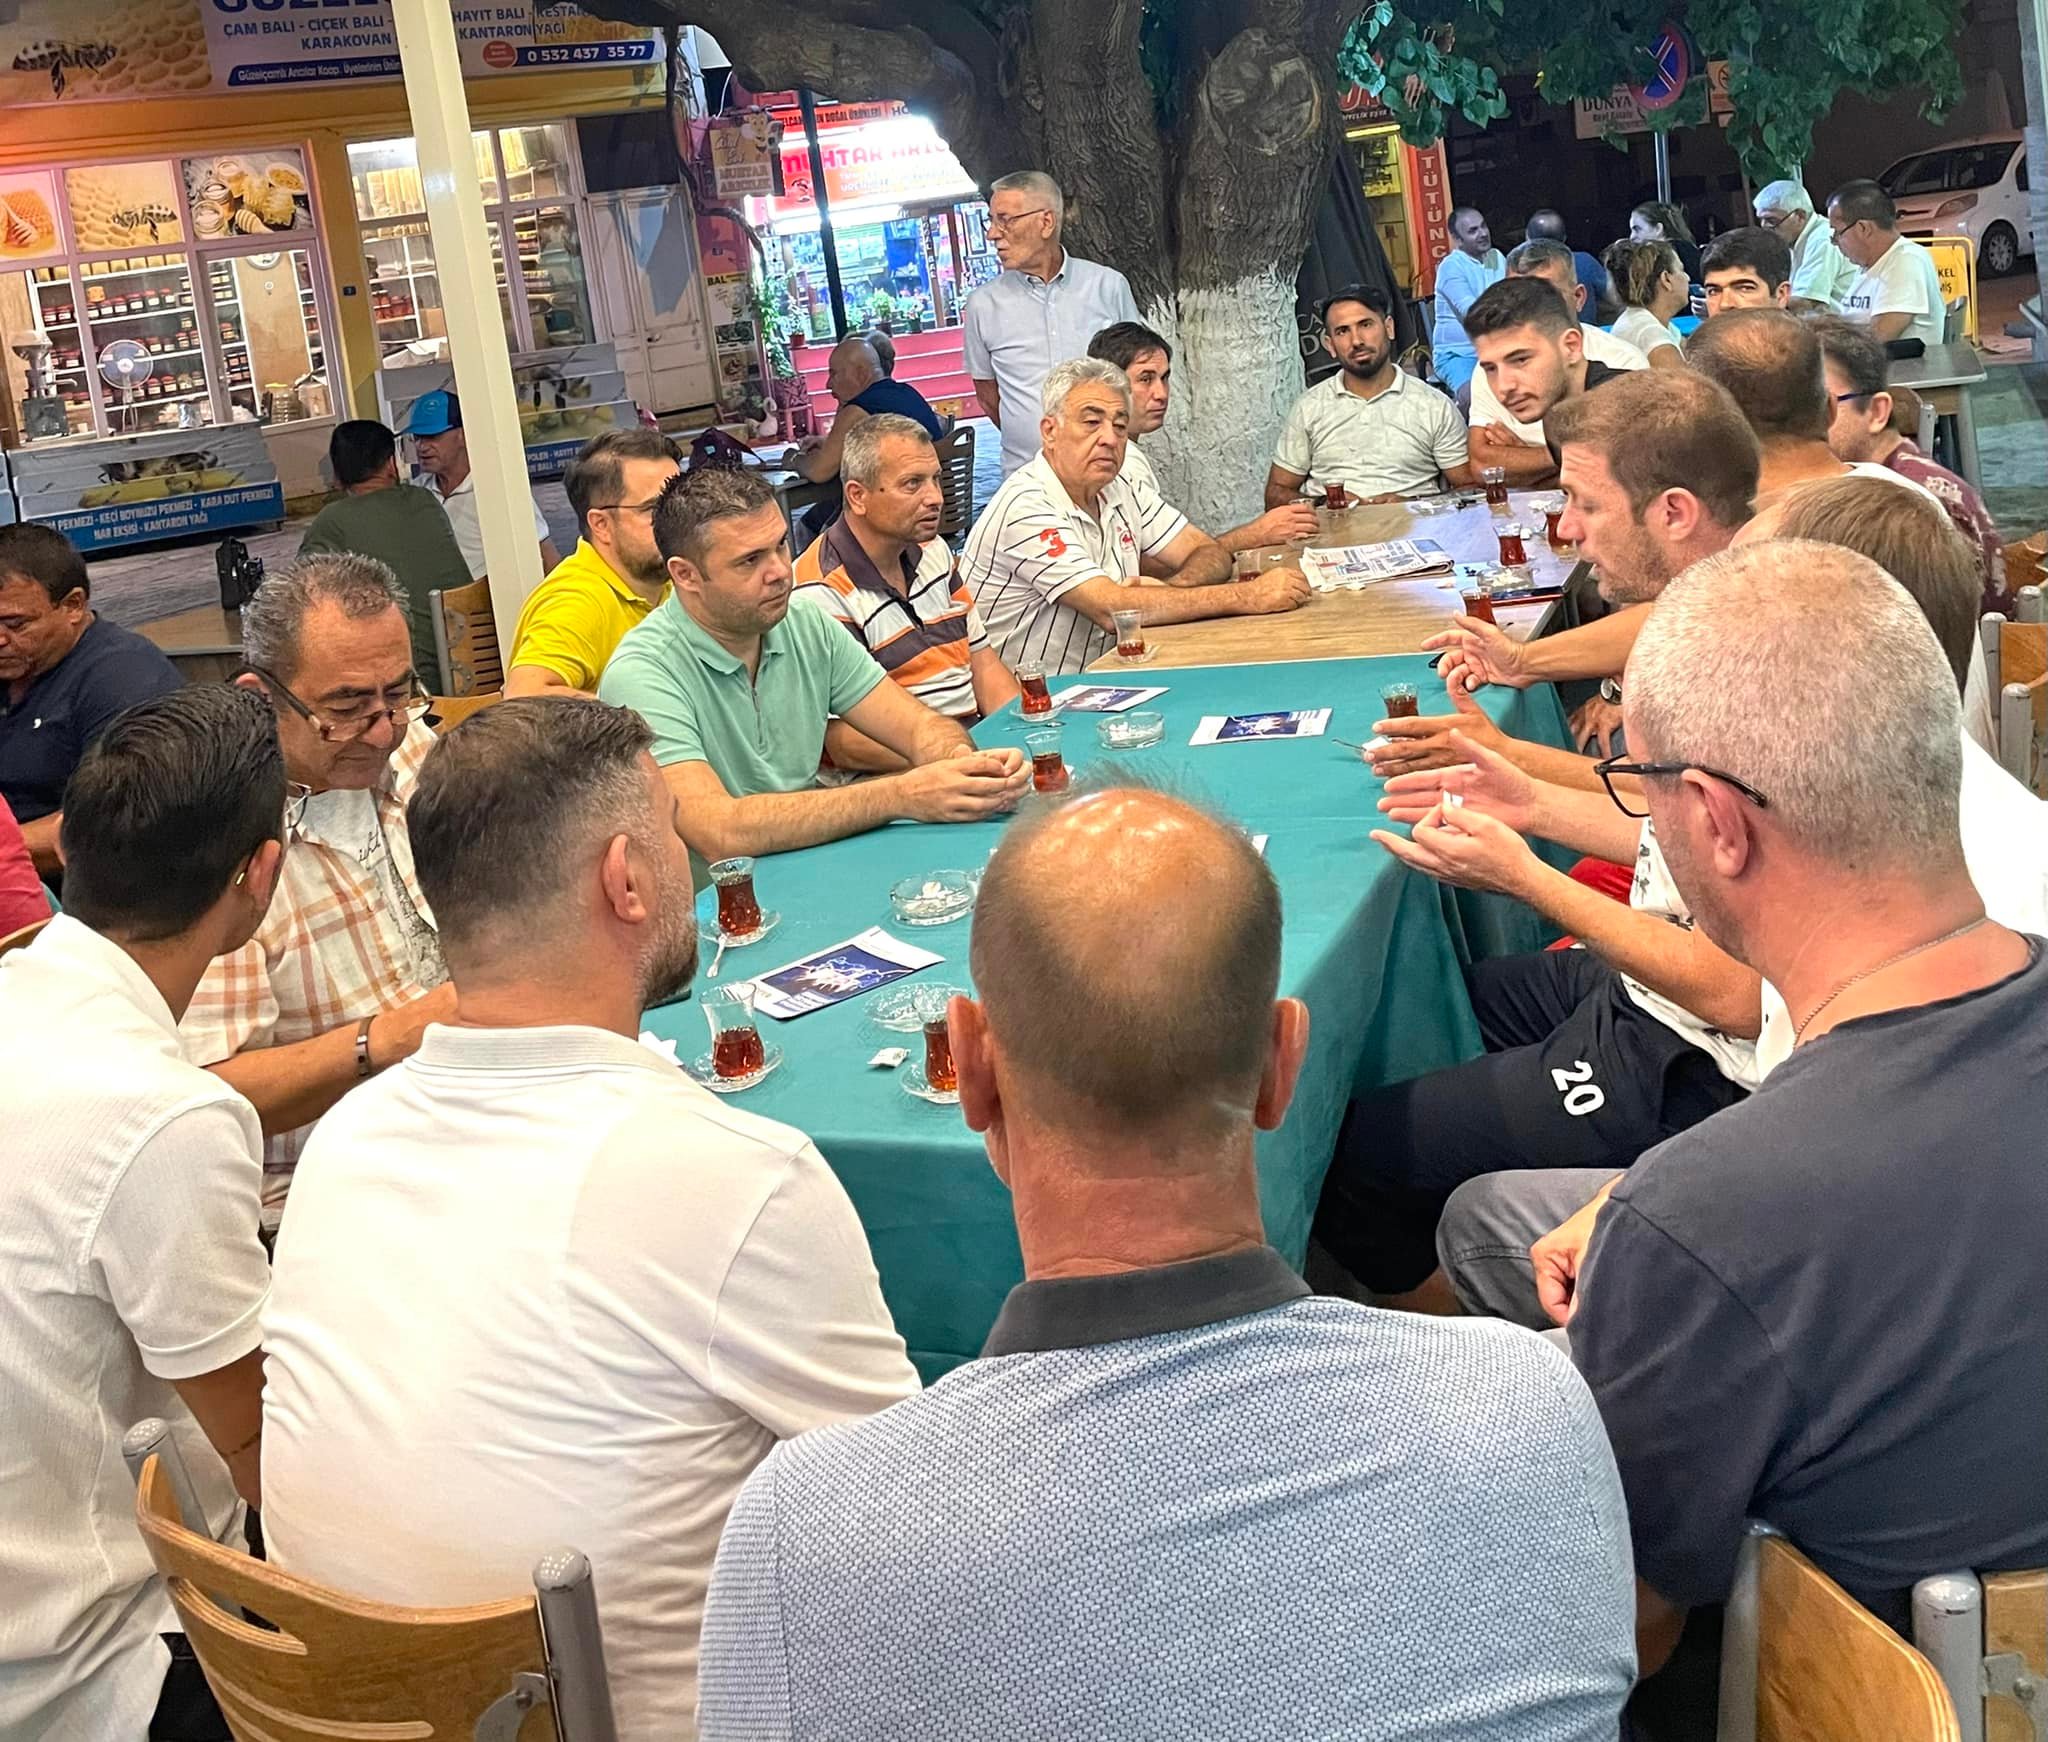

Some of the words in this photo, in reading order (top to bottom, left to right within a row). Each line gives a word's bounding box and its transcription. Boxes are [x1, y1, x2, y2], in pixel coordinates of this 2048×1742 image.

[497, 7, 525, 20] BALI
[223, 22, 258, 38] ÇAM
[262, 21, 295, 34] BALI
[353, 15, 384, 28] BALI
[458, 23, 532, 40] KANTARON
[301, 33, 392, 51] KARAKOVAN
[541, 48, 569, 61] 532
[573, 47, 600, 60] 437
[607, 46, 626, 58] 35
[629, 45, 646, 57] 77
[1421, 156, 1448, 260] TÜTÜNC
[707, 276, 727, 287] BAL
[1040, 528, 1067, 558] 3
[1551, 1060, 1604, 1116] 20
